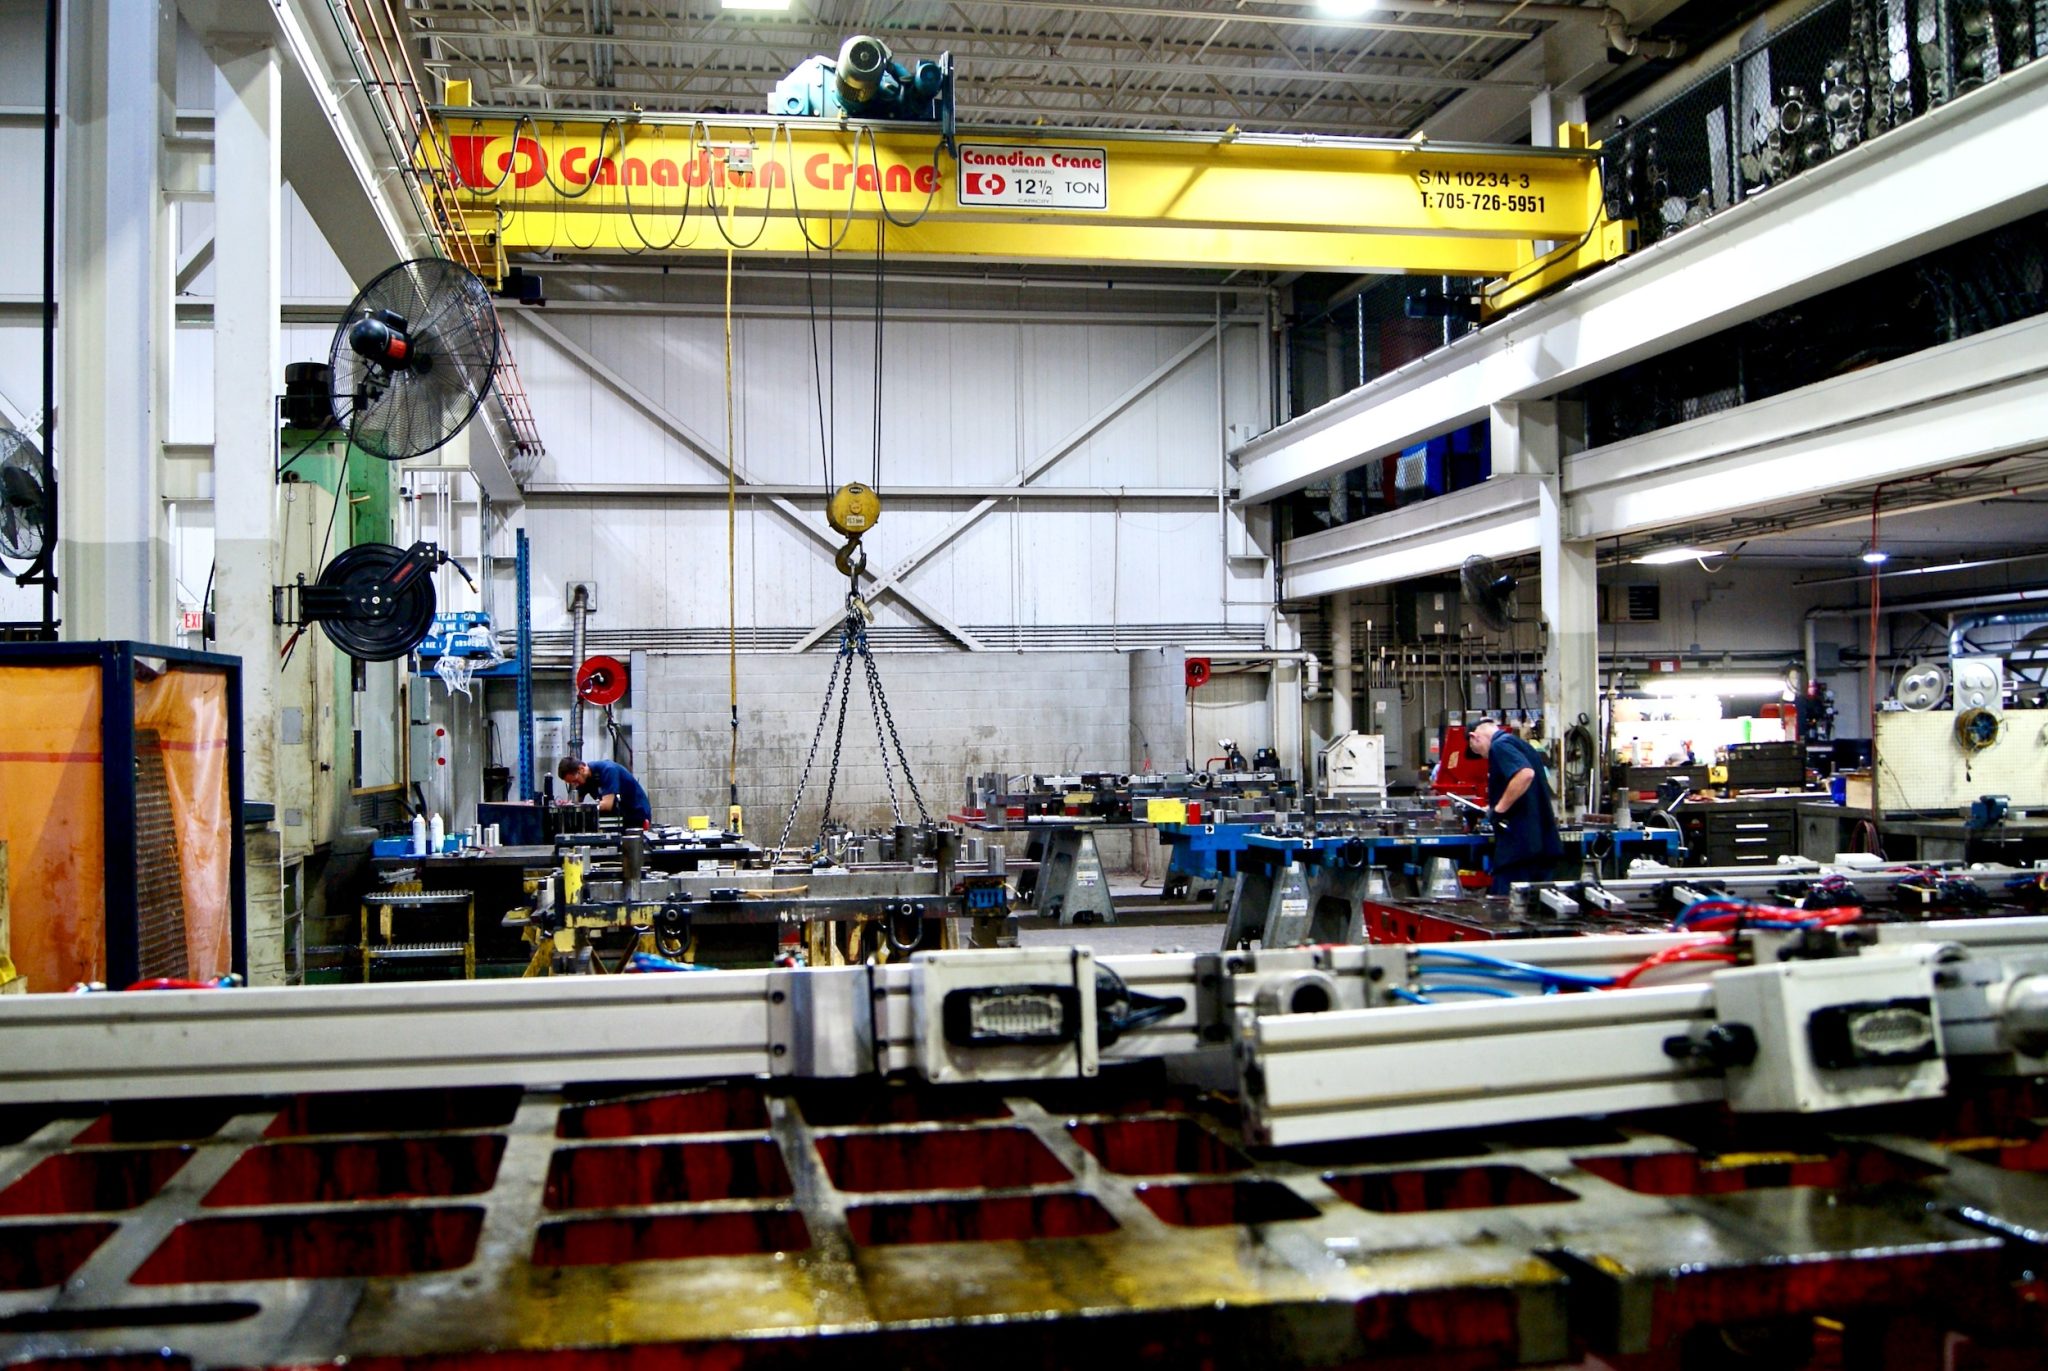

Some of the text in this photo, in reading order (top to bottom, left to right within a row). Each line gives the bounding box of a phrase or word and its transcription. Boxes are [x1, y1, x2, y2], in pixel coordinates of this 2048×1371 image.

[963, 150, 1102, 169] Canadian Crane
[560, 147, 942, 193] Canadian Crane
[1419, 169, 1530, 189] S/N 10234-3
[1065, 181, 1099, 194] TON
[184, 612, 203, 629] EXI
